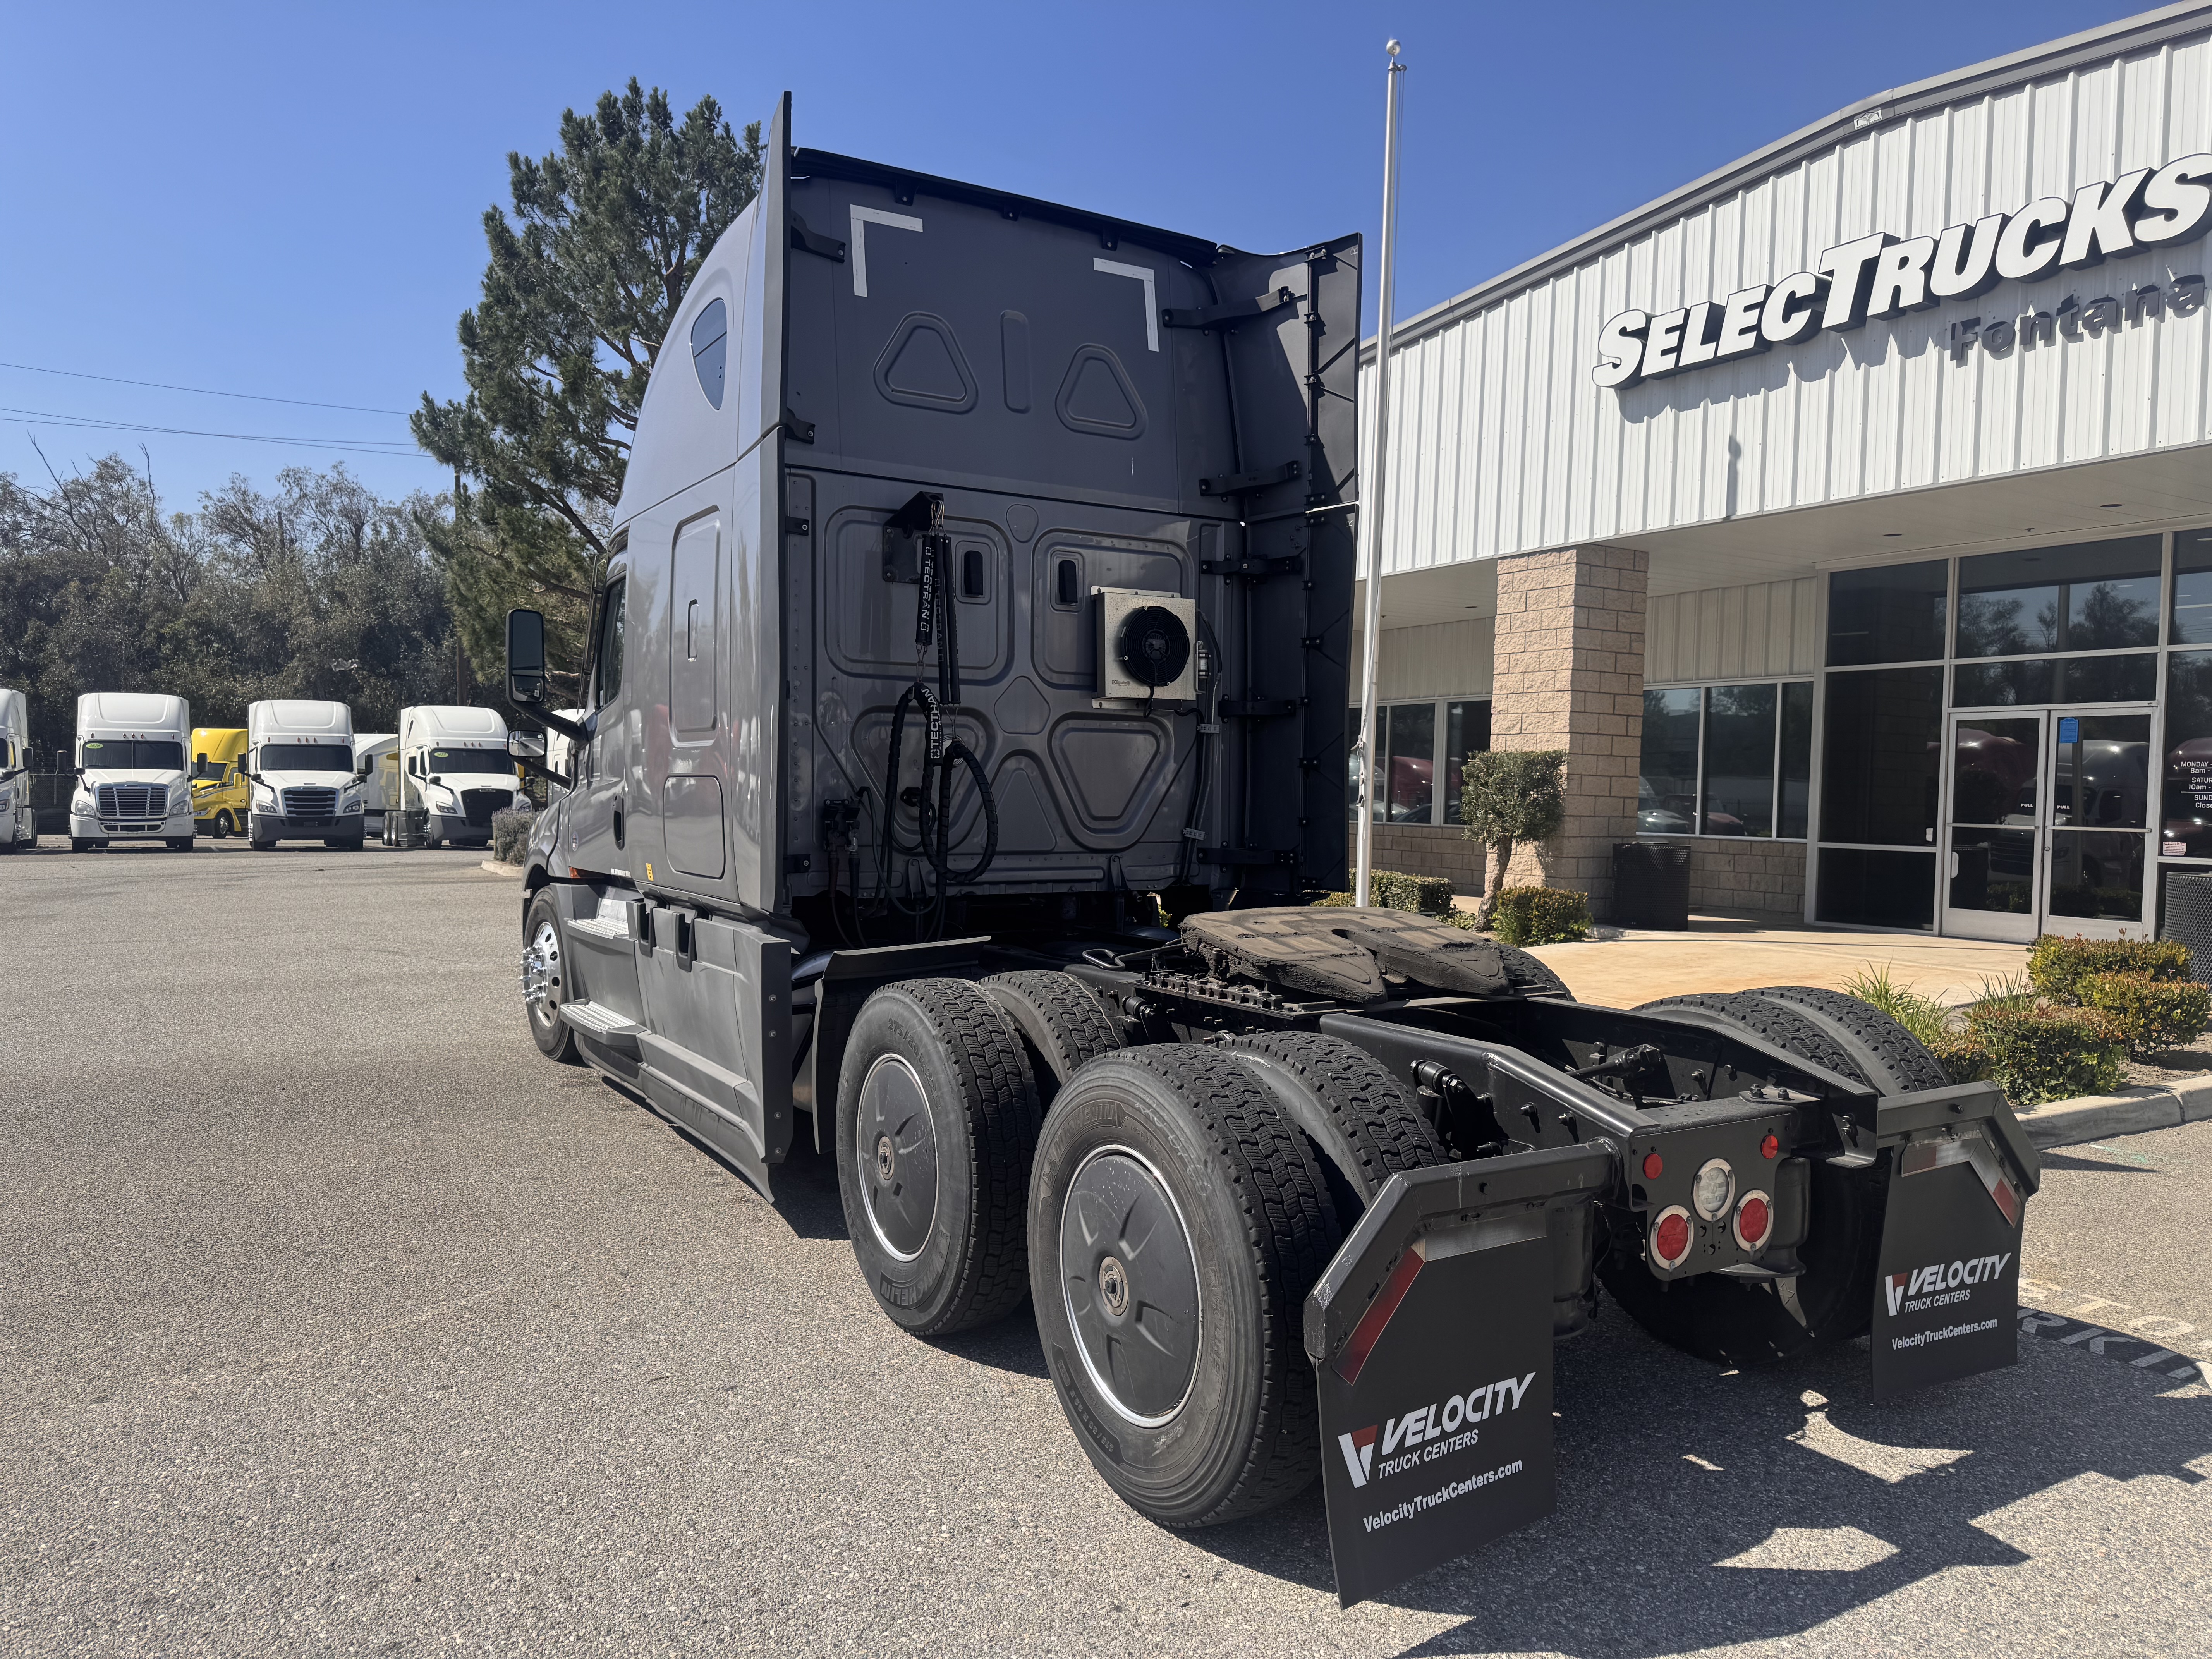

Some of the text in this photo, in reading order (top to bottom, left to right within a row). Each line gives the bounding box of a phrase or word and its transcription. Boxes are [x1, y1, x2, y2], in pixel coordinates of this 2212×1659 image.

[1950, 274, 2205, 361] Fontana
[922, 559, 931, 620] TECTRAN
[921, 689, 939, 749] TECTRAN
[1905, 1289, 1971, 1313] TRUCK CENTERS
[1908, 1252, 2012, 1296] VELOCITY
[1892, 1319, 1997, 1350] VelocityTruckCenters.com
[1381, 1372, 1536, 1456] VELOCITY
[1378, 1429, 1479, 1479] TRUCK CENTERS
[1363, 1459, 1522, 1532] VelocityTruckCenters.com
